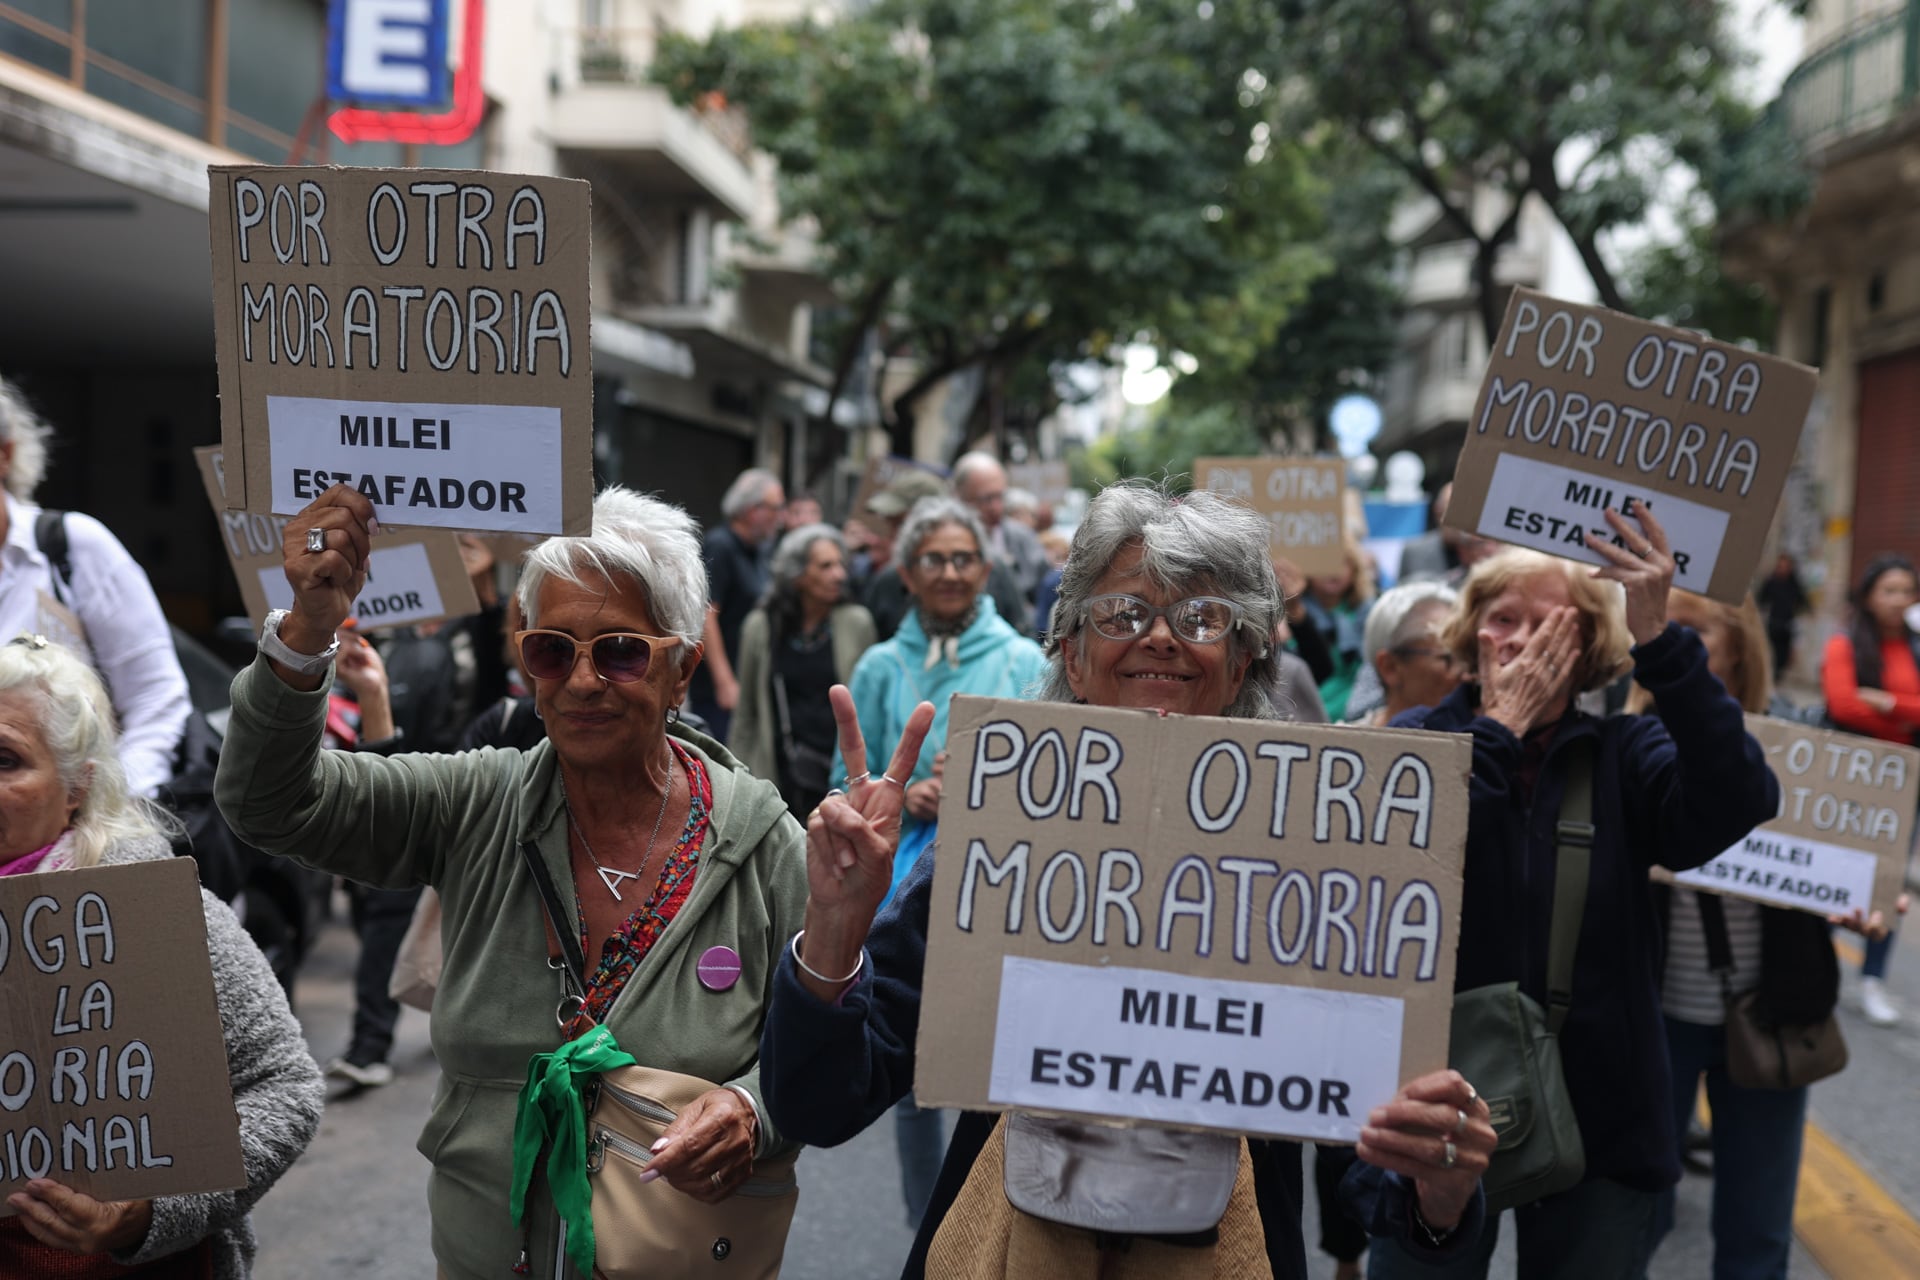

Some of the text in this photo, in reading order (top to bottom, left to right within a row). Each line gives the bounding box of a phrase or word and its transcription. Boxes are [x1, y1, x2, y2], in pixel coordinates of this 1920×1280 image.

[342, 0, 430, 95] E
[235, 177, 546, 271] POR OTRA
[241, 282, 571, 378] MORATORIA
[1504, 300, 1762, 415] POR OTRA
[340, 415, 451, 450] MILEI
[1477, 375, 1760, 497] MORATORIA
[1266, 466, 1337, 500] OTRA
[1269, 510, 1338, 548] TORIA
[1504, 506, 1691, 575] ESTAAR
[354, 591, 424, 618] ADOR
[967, 719, 1435, 849] POR OTRA
[1778, 785, 1899, 842] TORIA
[1744, 838, 1814, 867] MILEI
[0, 891, 115, 976] GA
[956, 837, 1442, 982] MORATORIA
[52, 980, 115, 1035] LA
[1120, 987, 1264, 1037] MILEI
[1030, 1047, 1351, 1117] ESTAFADOR
[0, 1113, 175, 1183] IONAL
